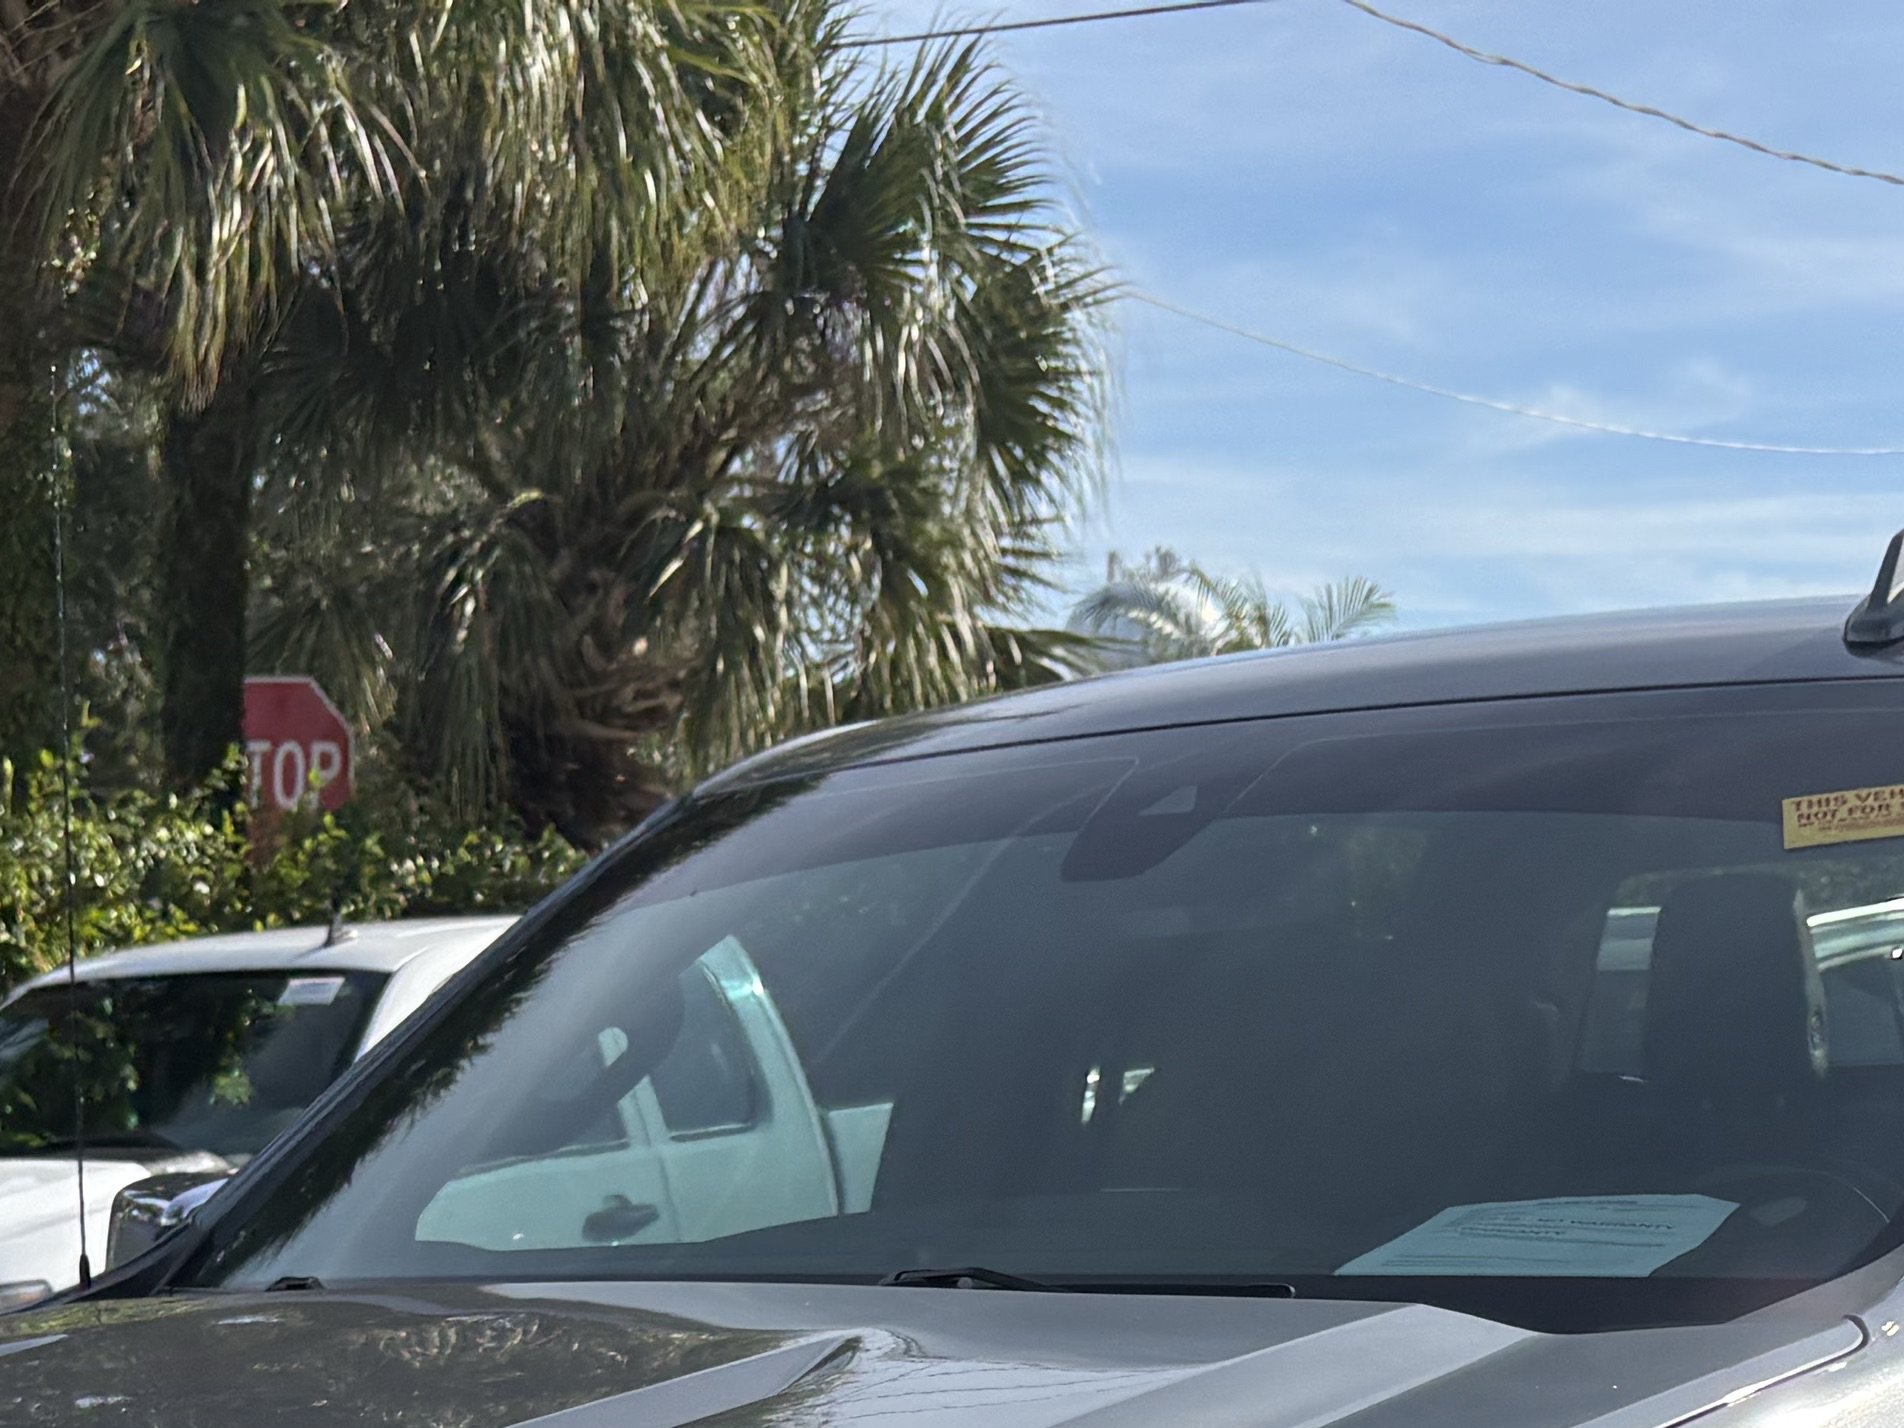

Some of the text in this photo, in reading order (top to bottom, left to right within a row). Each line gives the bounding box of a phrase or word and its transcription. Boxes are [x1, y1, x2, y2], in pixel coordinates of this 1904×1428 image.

[244, 738, 343, 813] TOP
[1792, 794, 1847, 813] THIS
[1797, 808, 1840, 824] NOT
[1848, 803, 1892, 817] FOR
